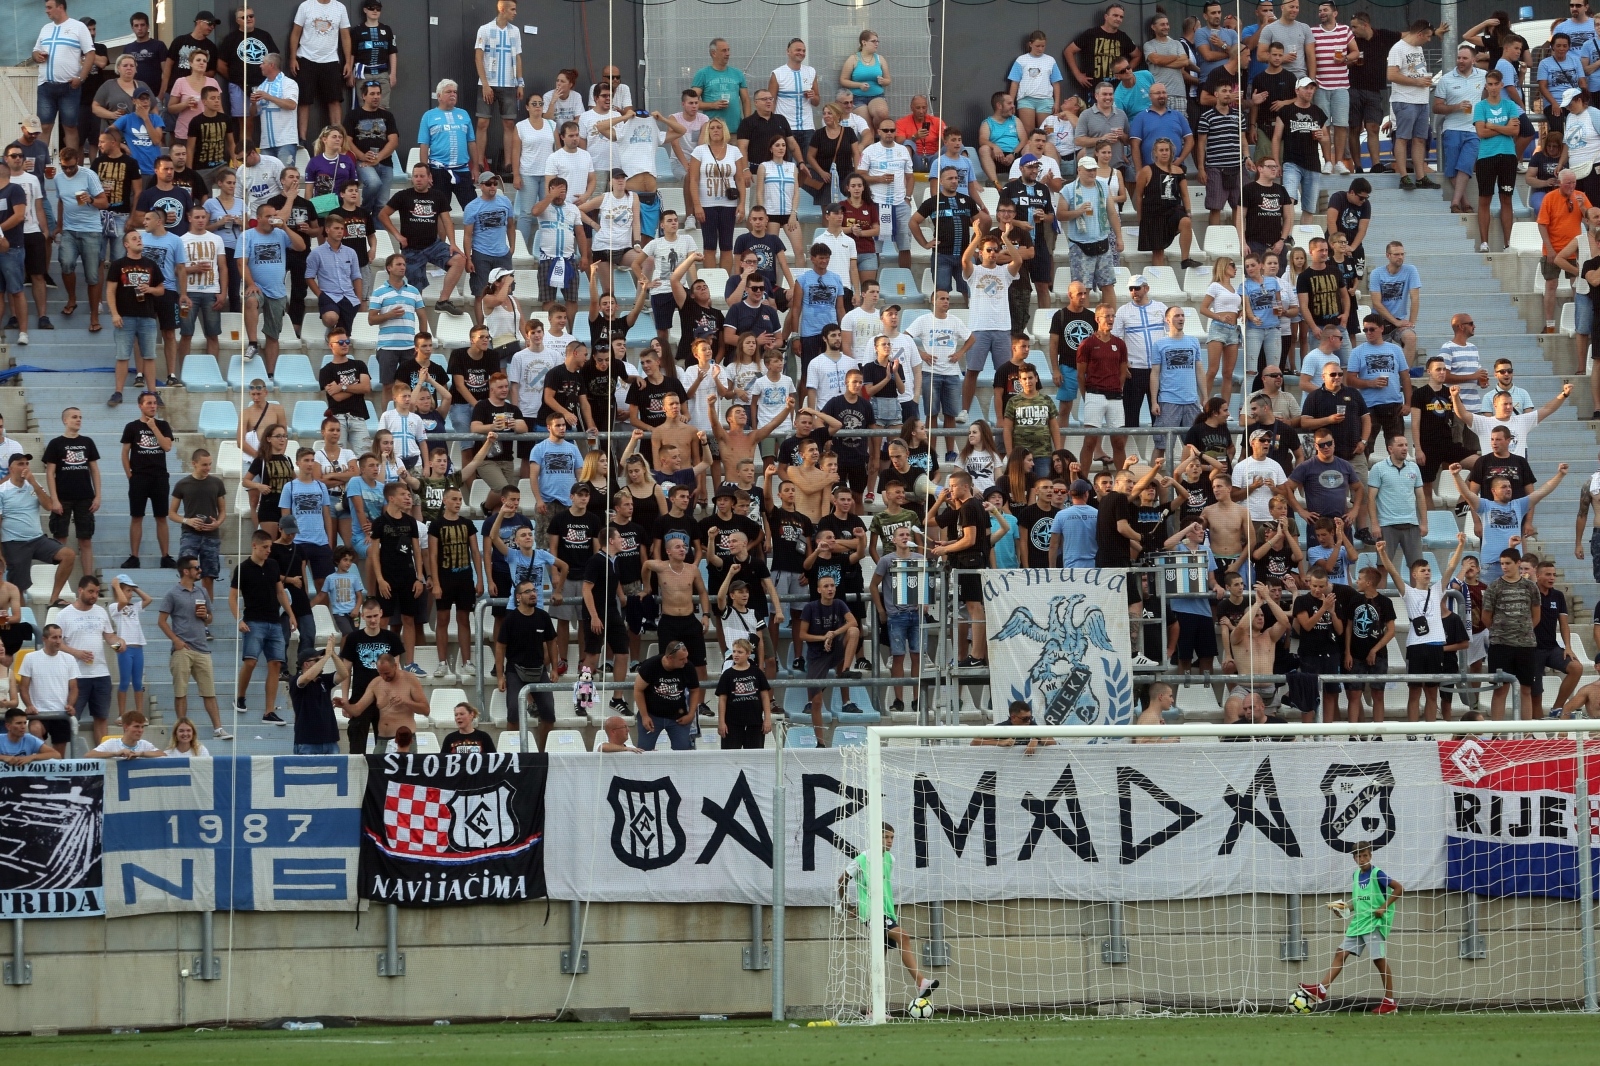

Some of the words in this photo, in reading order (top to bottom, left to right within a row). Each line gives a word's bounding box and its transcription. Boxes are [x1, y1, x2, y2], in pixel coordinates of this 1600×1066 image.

[1046, 681, 1058, 692] NK
[1045, 670, 1088, 725] RIJEKA
[27, 763, 56, 772] ZOVE
[58, 763, 73, 772] SE
[76, 762, 100, 772] DOM
[167, 813, 313, 845] 1987
